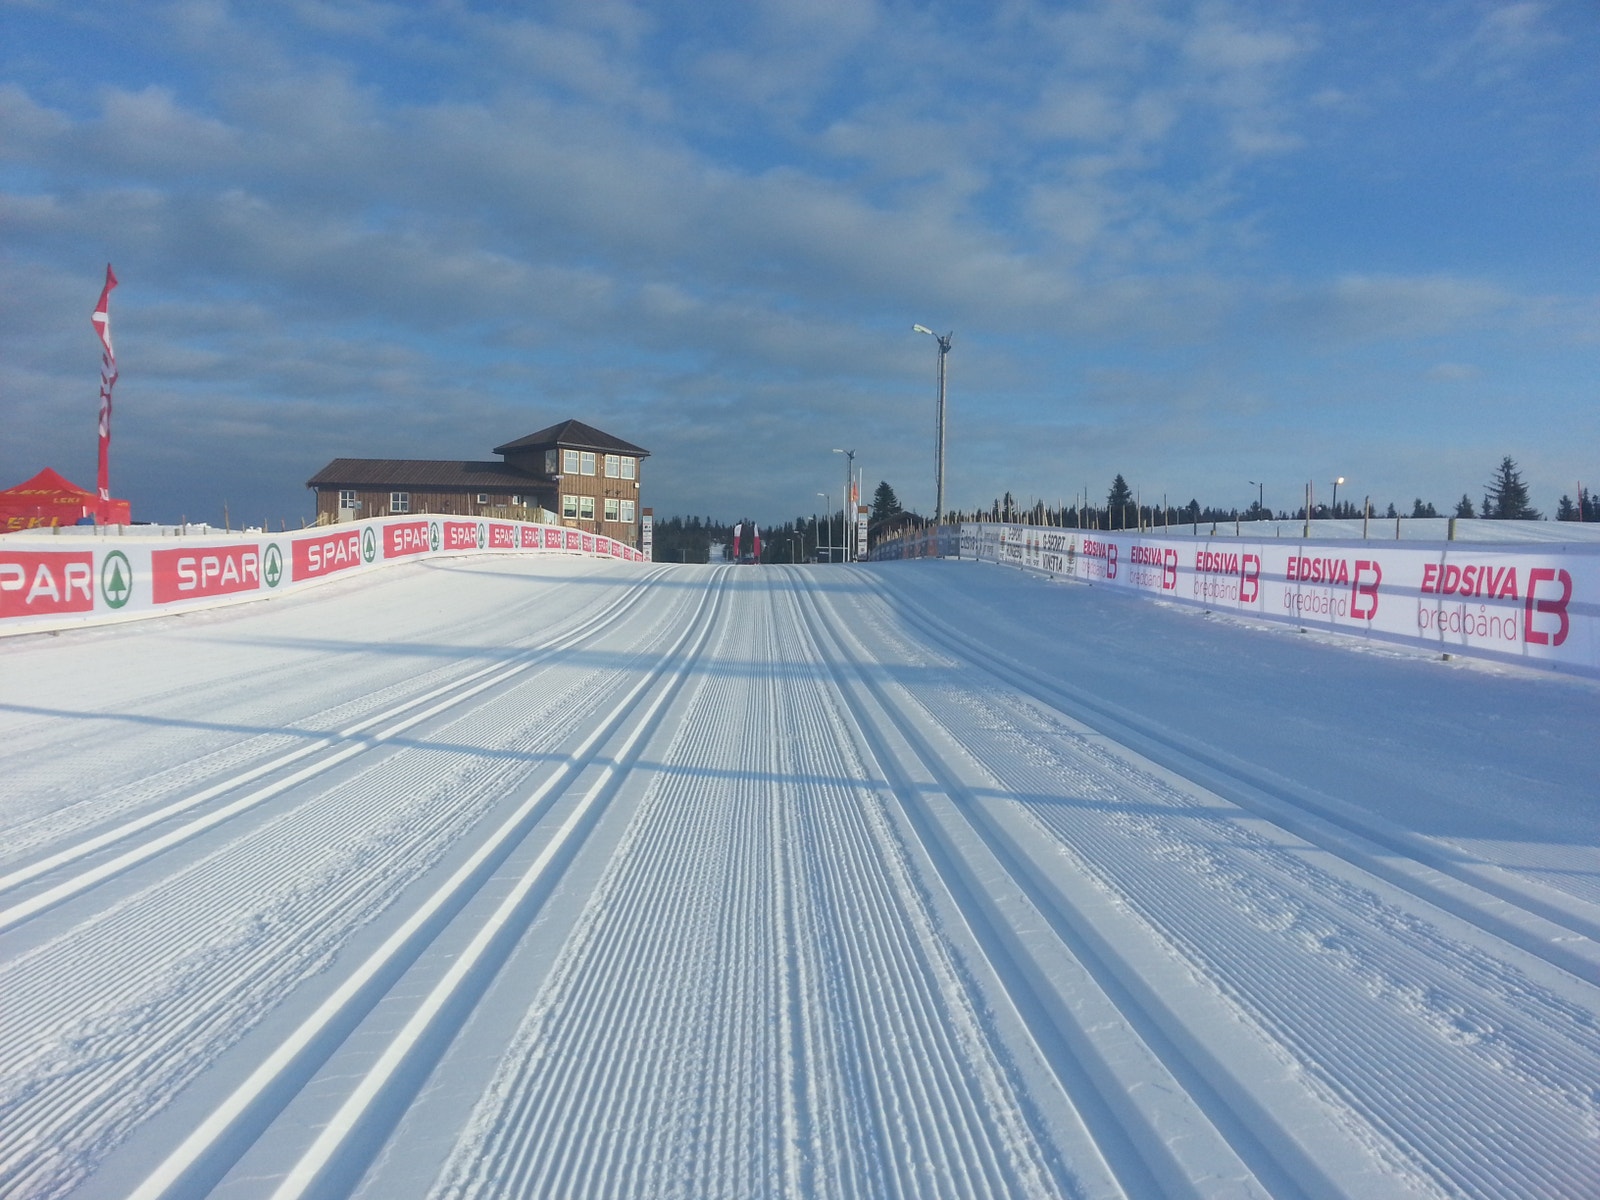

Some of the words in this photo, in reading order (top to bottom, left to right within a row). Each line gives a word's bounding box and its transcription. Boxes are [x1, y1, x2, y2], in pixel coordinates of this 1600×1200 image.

[394, 527, 430, 551] SPAR
[450, 527, 477, 545] SPAR
[494, 528, 514, 544] SPAR
[308, 536, 360, 572] SPAR
[1083, 539, 1106, 559] EIDSIVA
[1130, 545, 1162, 567] EIDSIVA
[177, 552, 259, 591] SPAR
[1195, 552, 1239, 575] EIDSIVA
[1286, 556, 1348, 586] EIDSIVA
[1129, 566, 1161, 588] bredbånd
[1193, 576, 1238, 601] bredbånd
[1420, 563, 1518, 600] EIDSIVA
[1283, 587, 1347, 617] bredbånd
[1418, 600, 1517, 641] bredbånd
